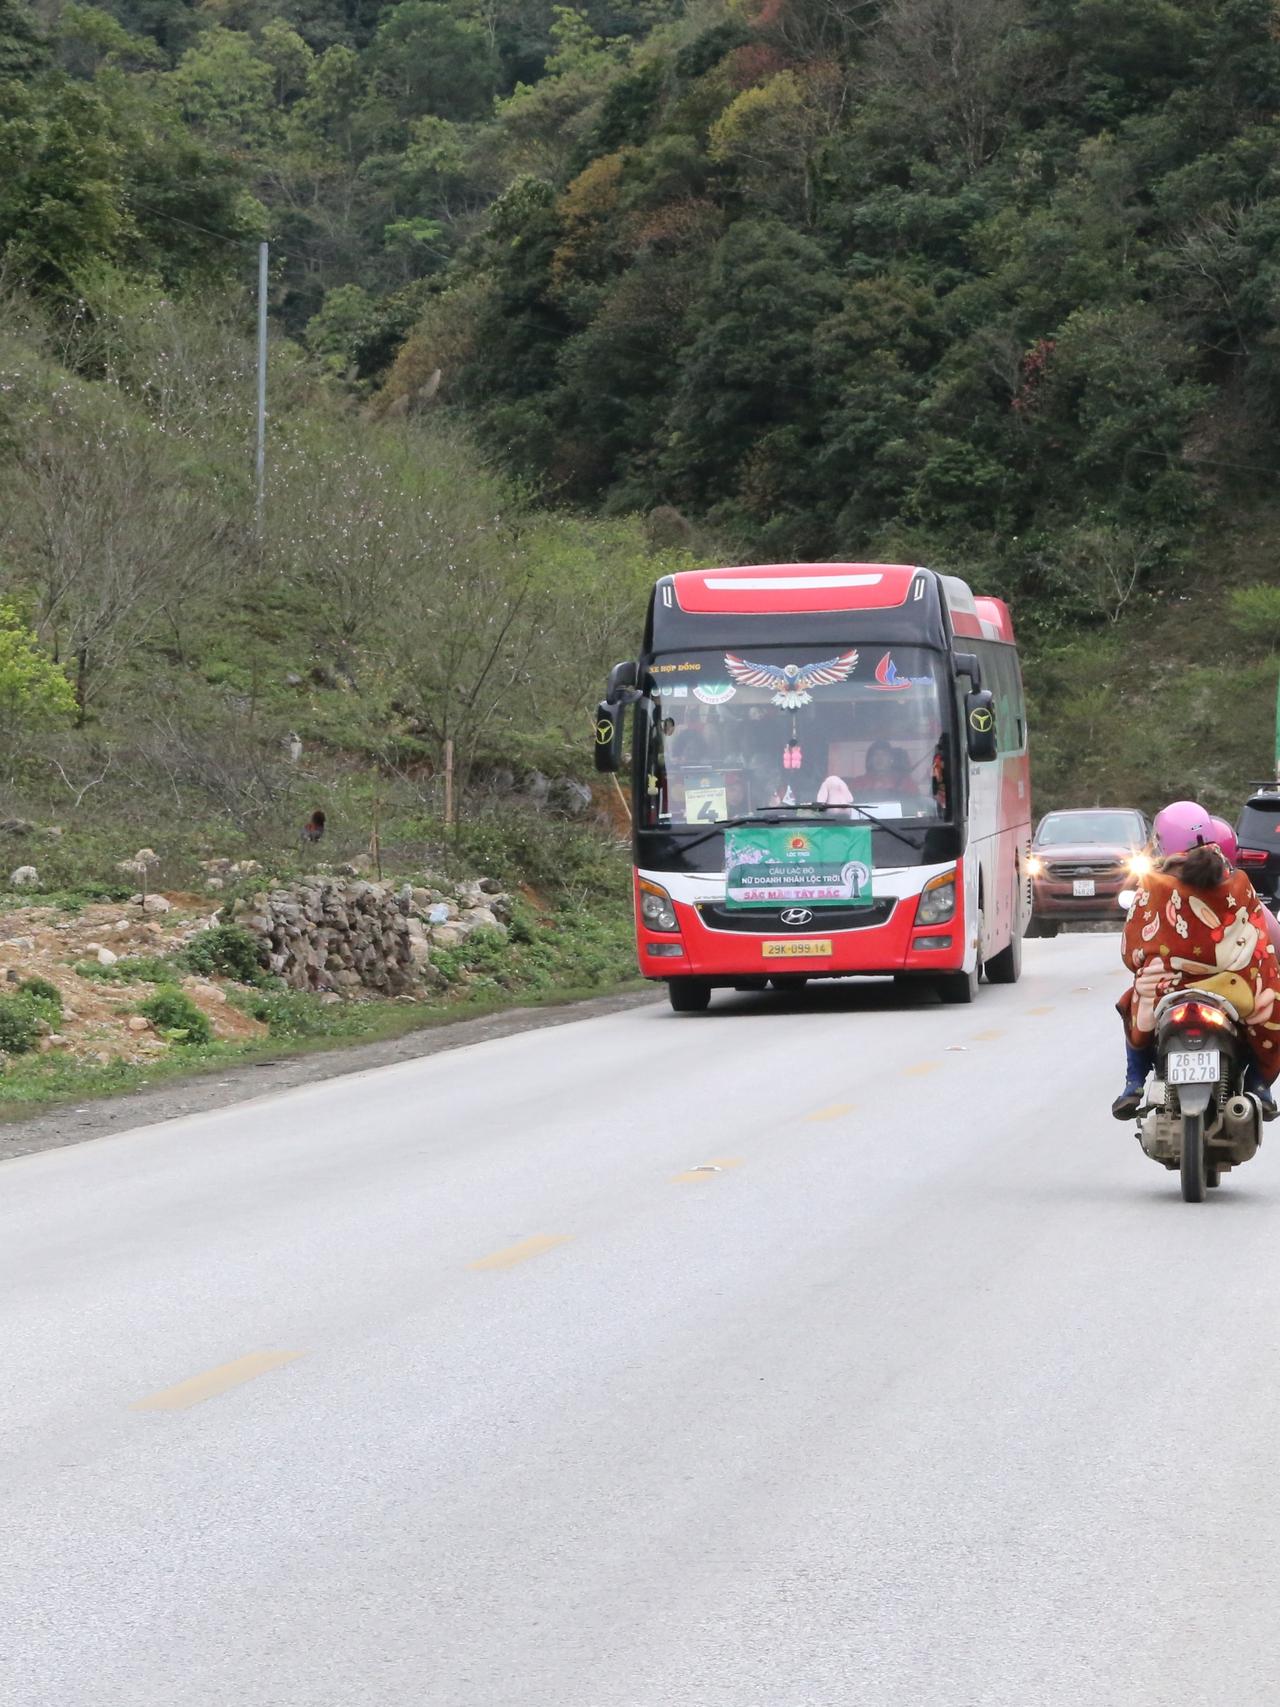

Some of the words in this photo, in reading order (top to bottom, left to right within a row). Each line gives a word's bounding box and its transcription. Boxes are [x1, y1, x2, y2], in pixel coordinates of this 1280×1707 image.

[697, 800, 719, 823] 4
[783, 875, 805, 883] NHÂN
[806, 875, 821, 884] LỘC
[1176, 1053, 1211, 1067] 26-B1
[1172, 1067, 1216, 1081] 012.78
